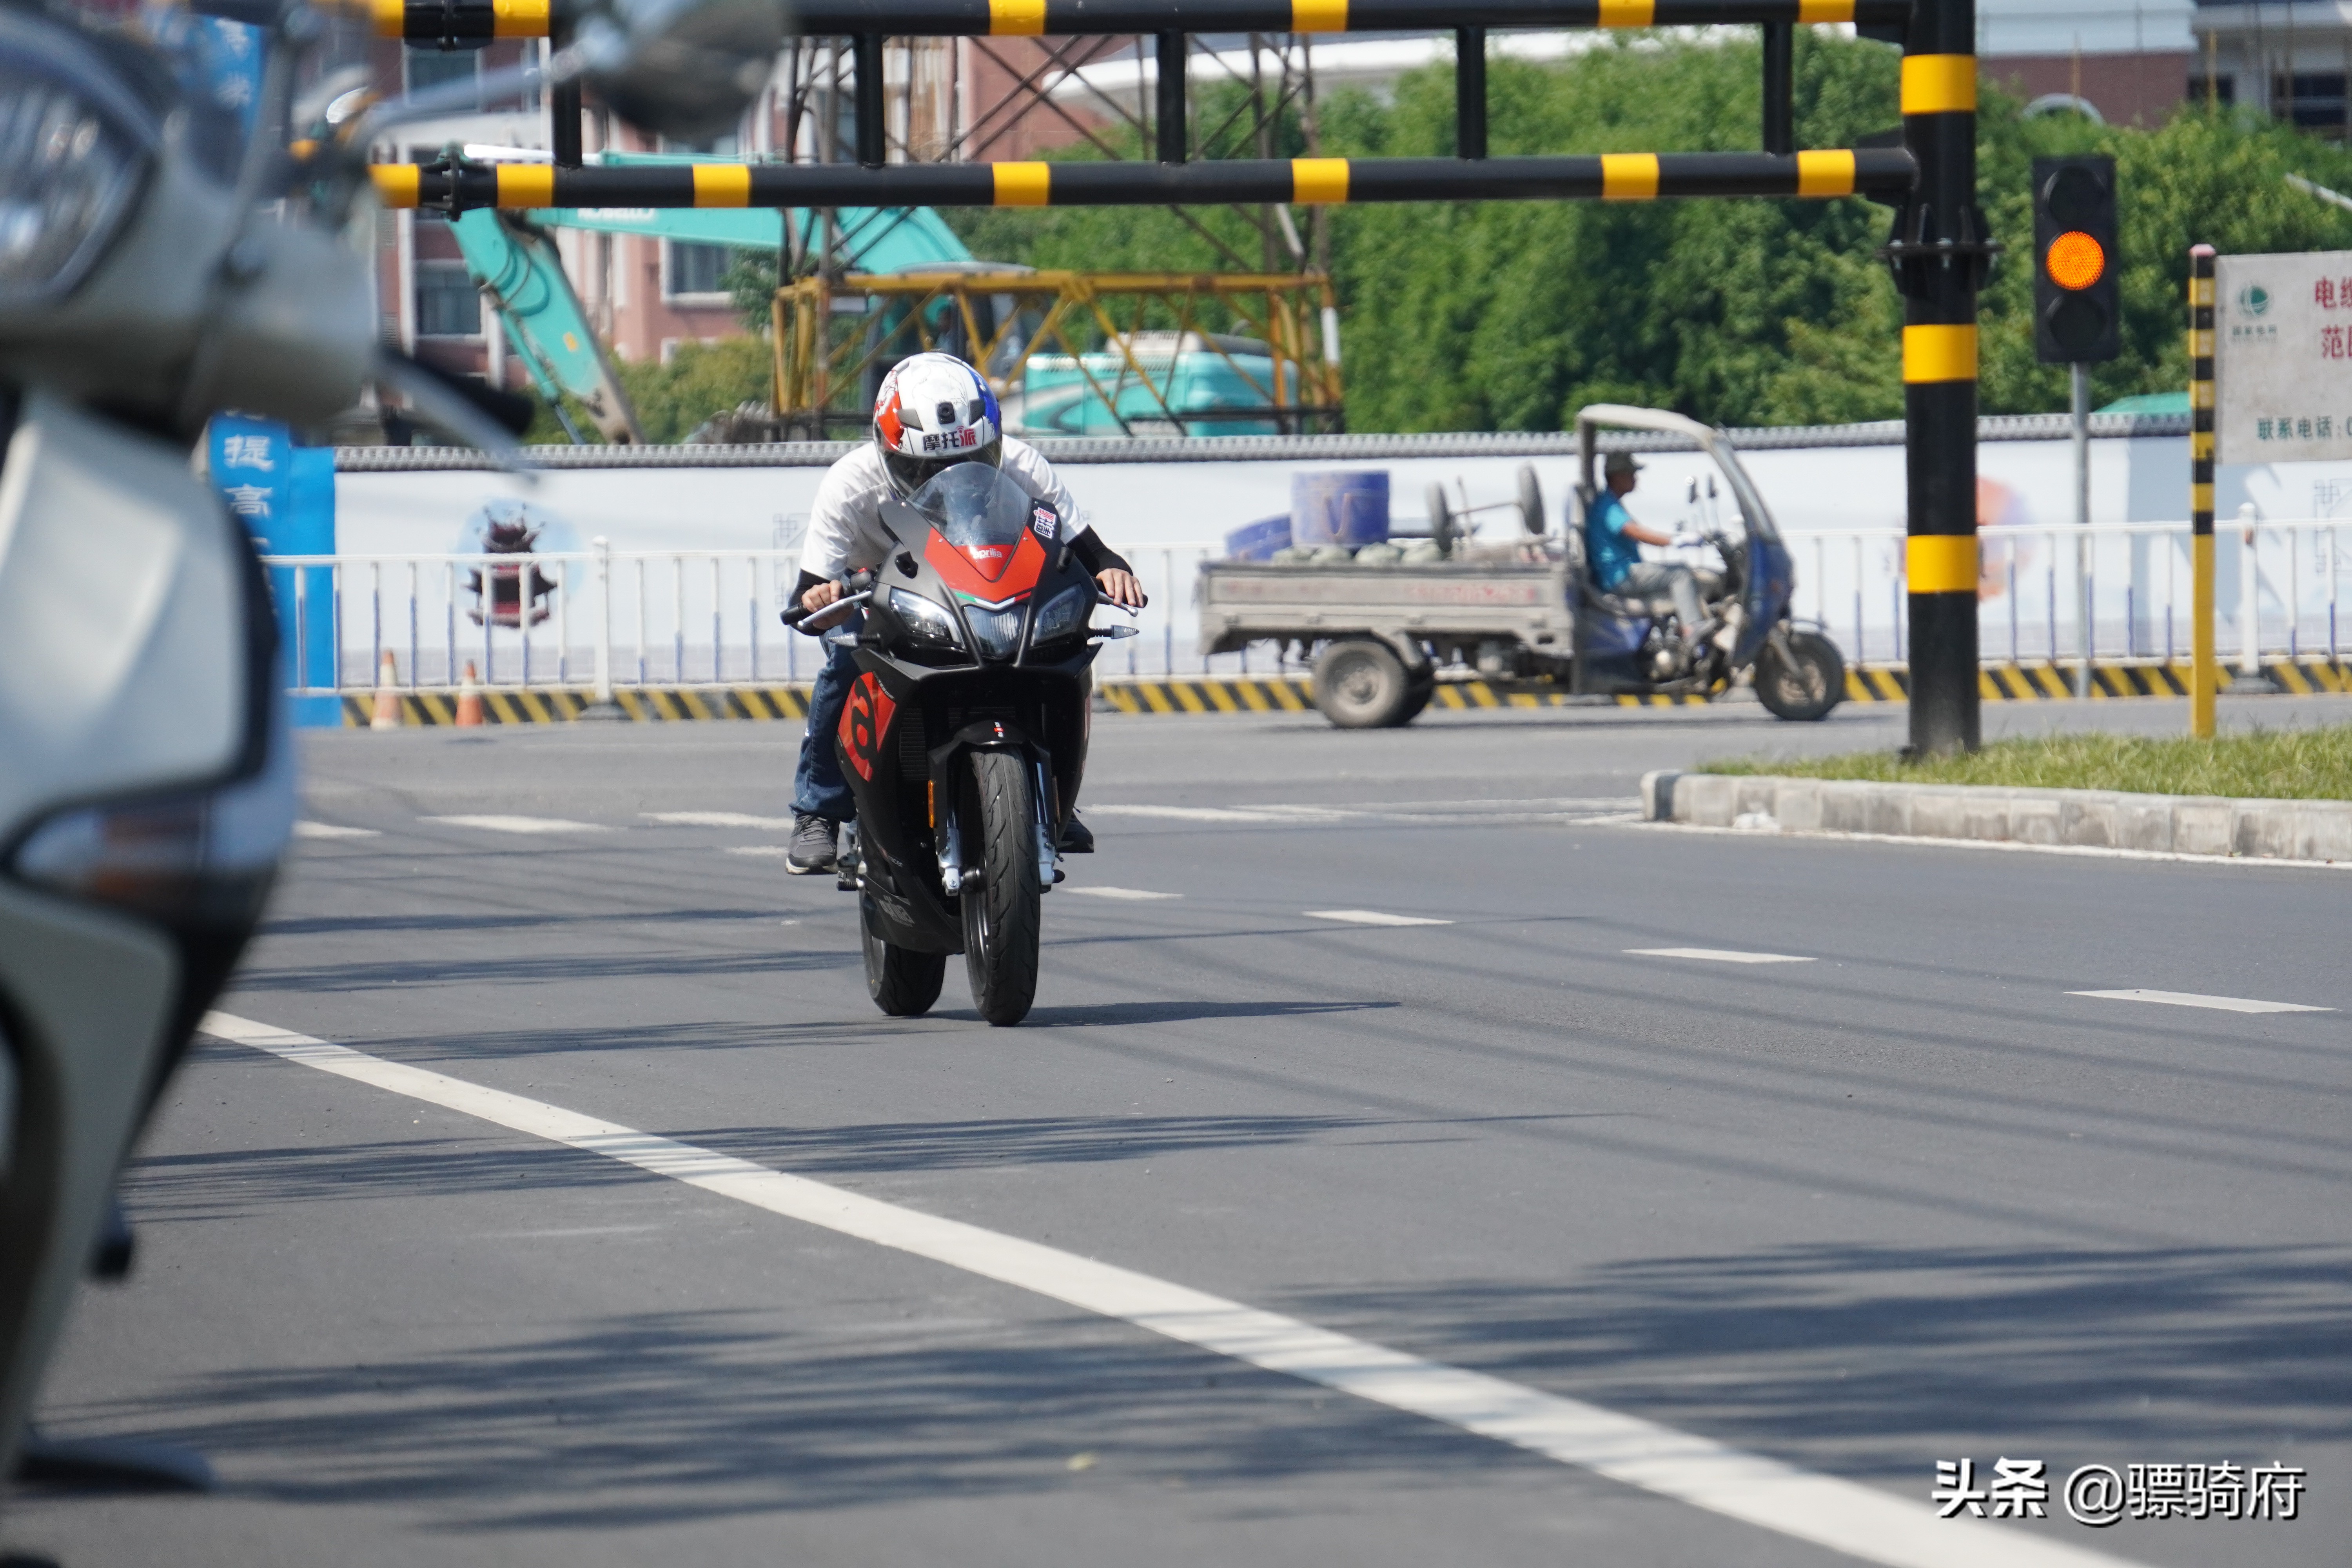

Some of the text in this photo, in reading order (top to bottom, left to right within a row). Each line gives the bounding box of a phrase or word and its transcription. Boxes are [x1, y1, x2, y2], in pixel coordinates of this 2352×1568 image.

[2321, 325, 2352, 359] 范
[922, 426, 976, 451] 摩托派
[973, 548, 1002, 559] aprilia
